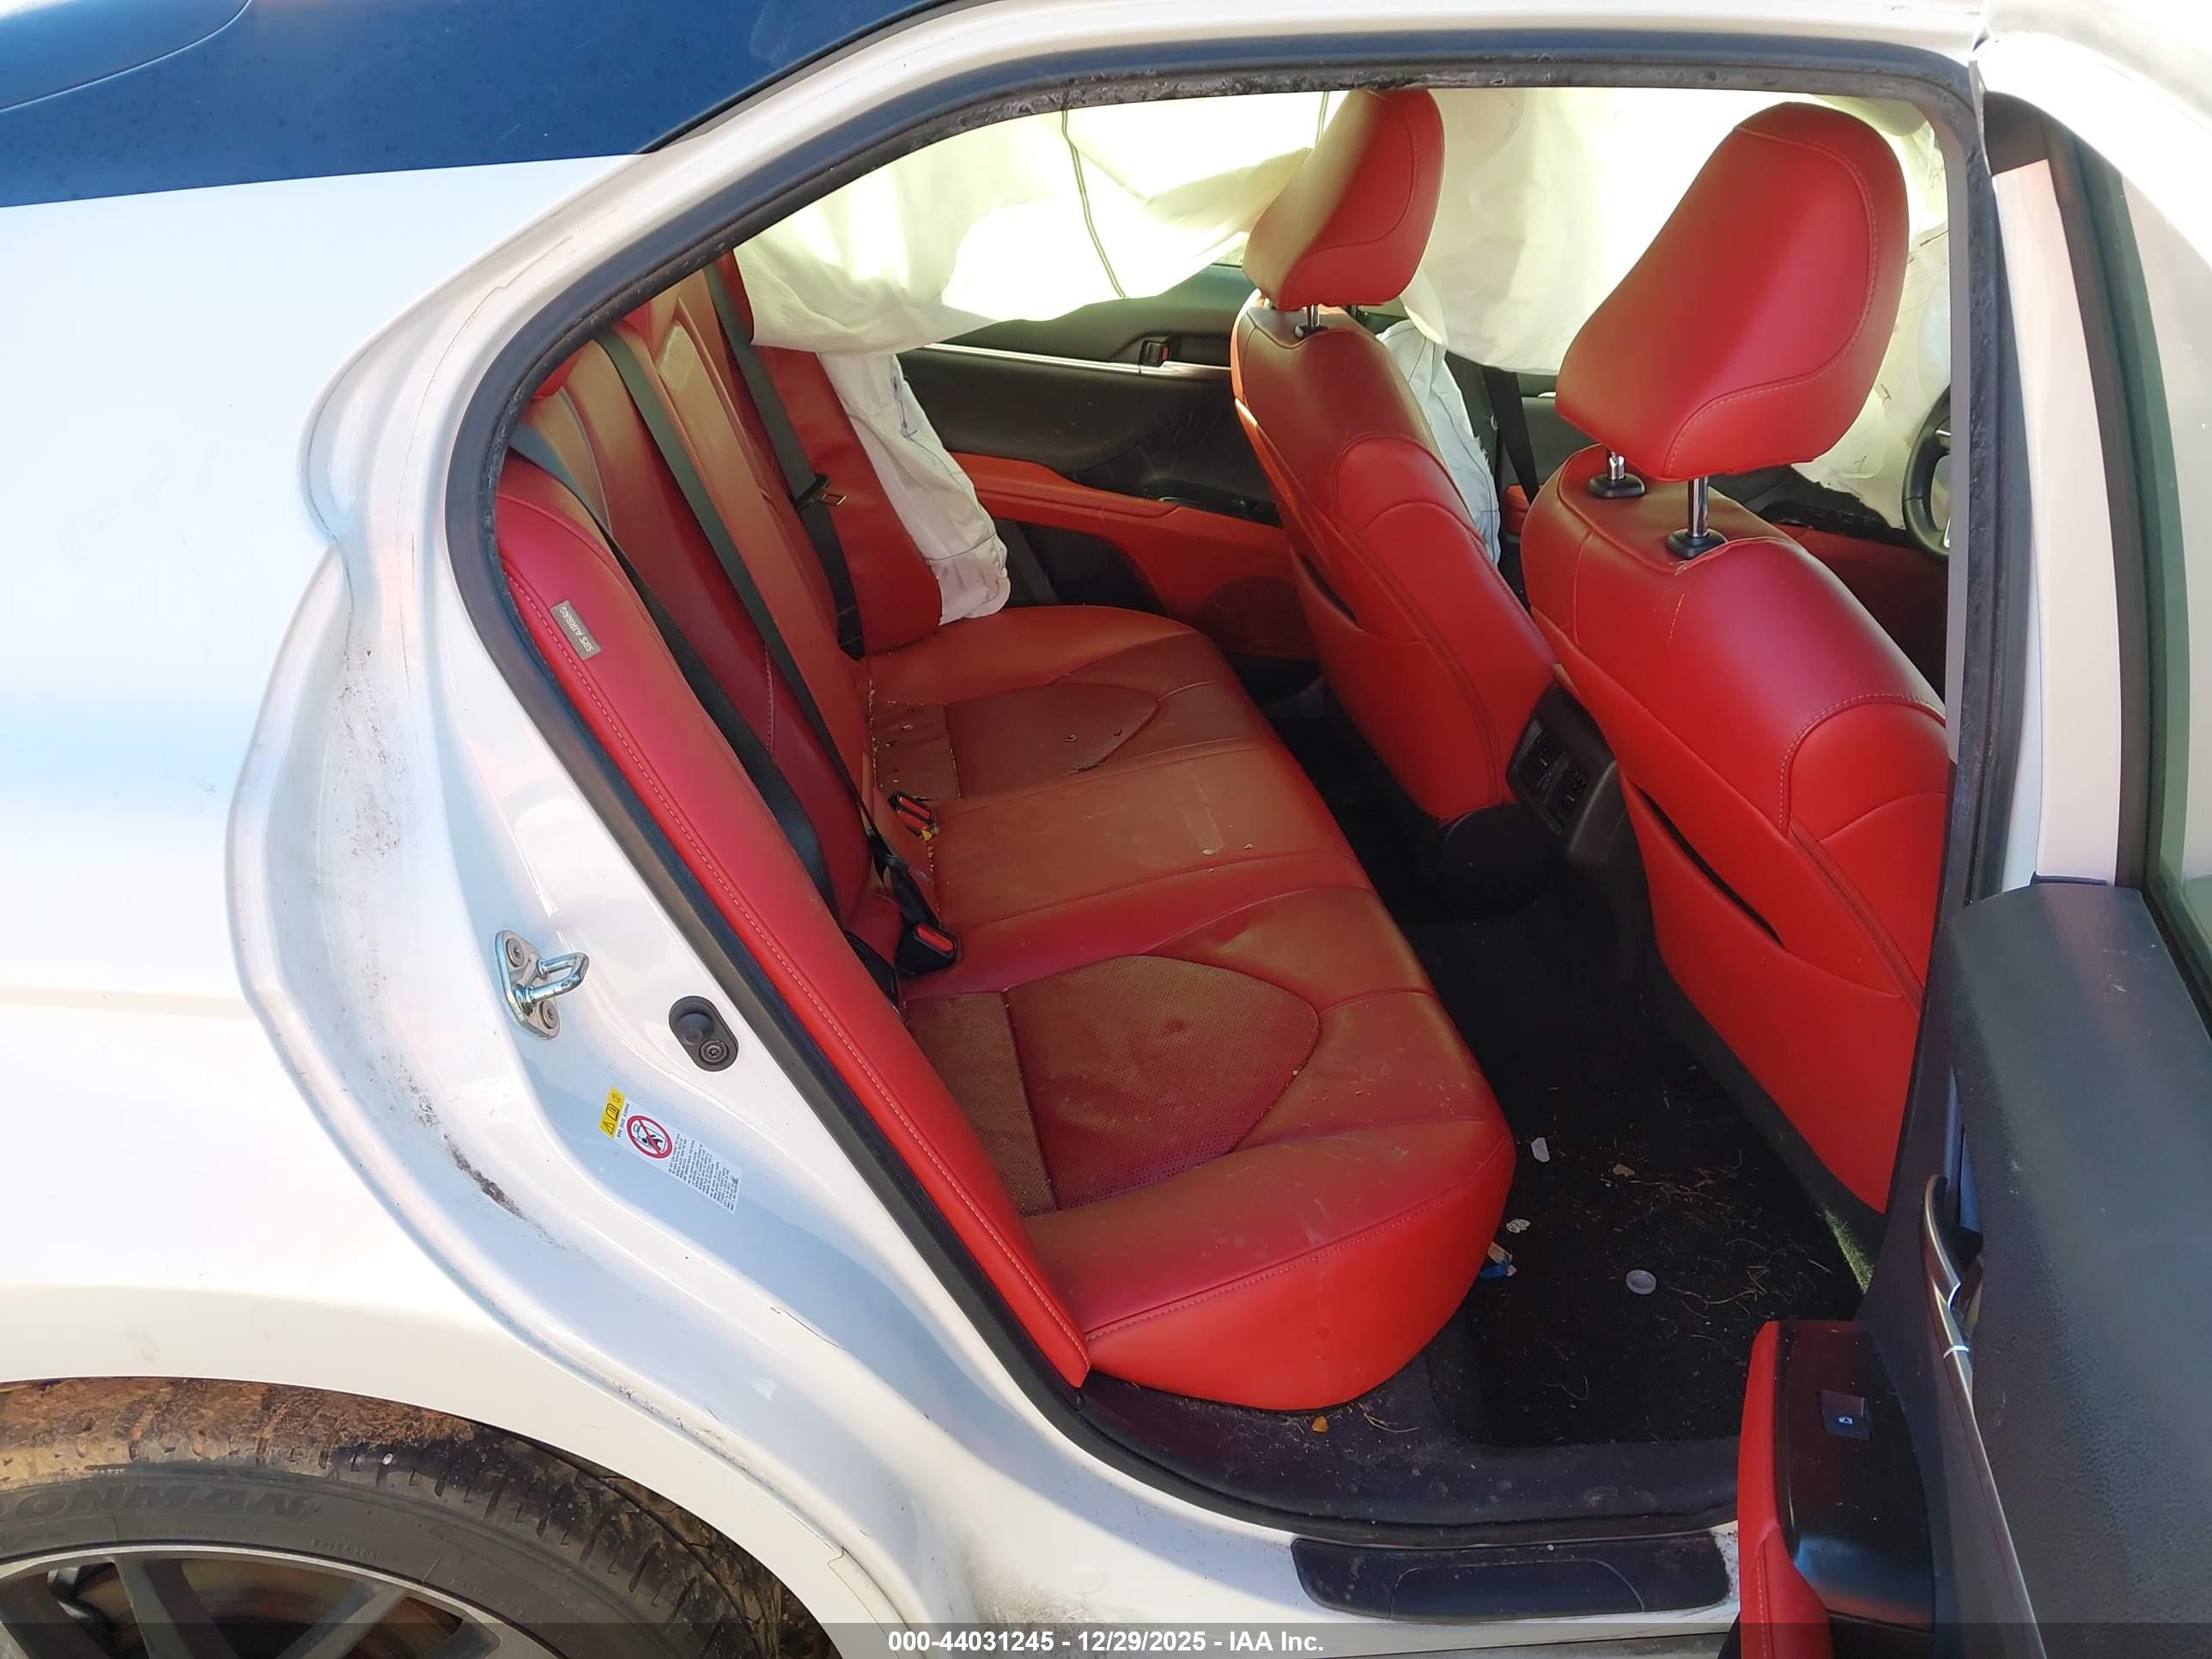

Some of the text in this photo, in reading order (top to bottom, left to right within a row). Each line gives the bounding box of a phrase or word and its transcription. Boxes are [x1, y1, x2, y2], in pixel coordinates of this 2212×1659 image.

[559, 606, 594, 652] SRS AIRBAG
[0, 1484, 314, 1519] ONMAN
